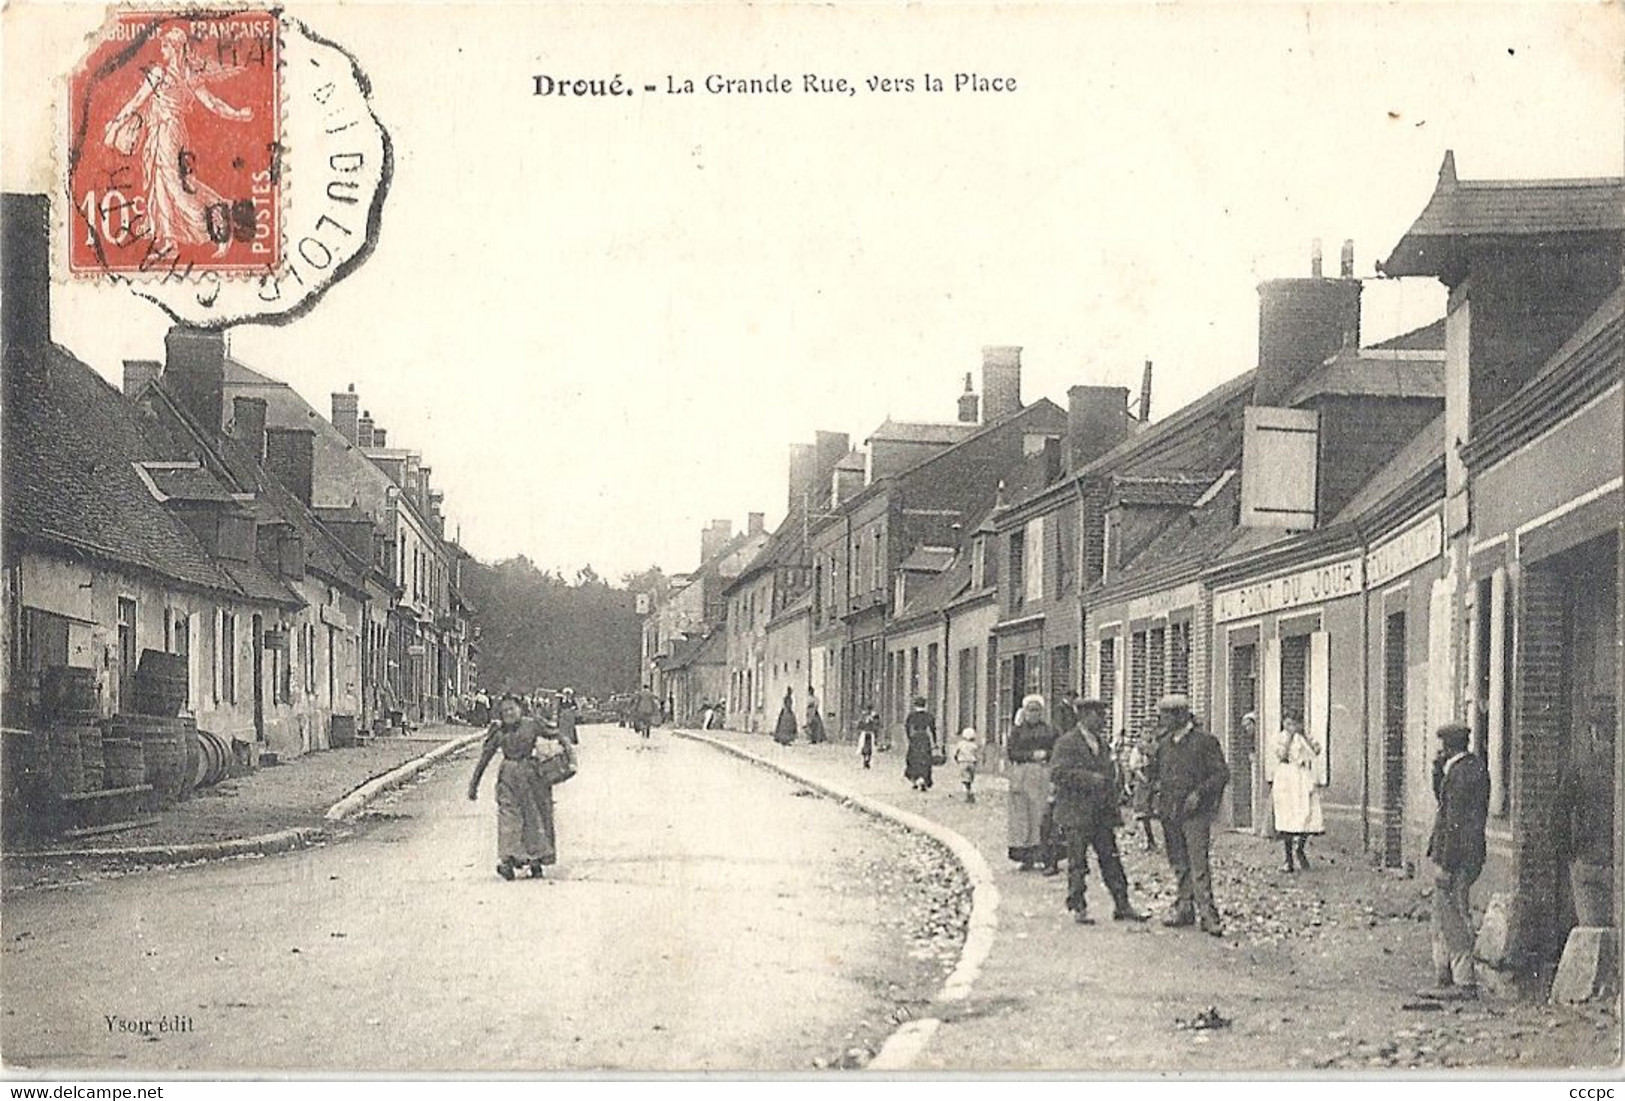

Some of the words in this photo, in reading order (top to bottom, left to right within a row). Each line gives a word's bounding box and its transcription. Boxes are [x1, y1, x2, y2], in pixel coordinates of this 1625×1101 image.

[190, 20, 270, 41] FRANÇAISE
[1282, 577, 1301, 604] DU
[1311, 563, 1354, 598] JOUR
